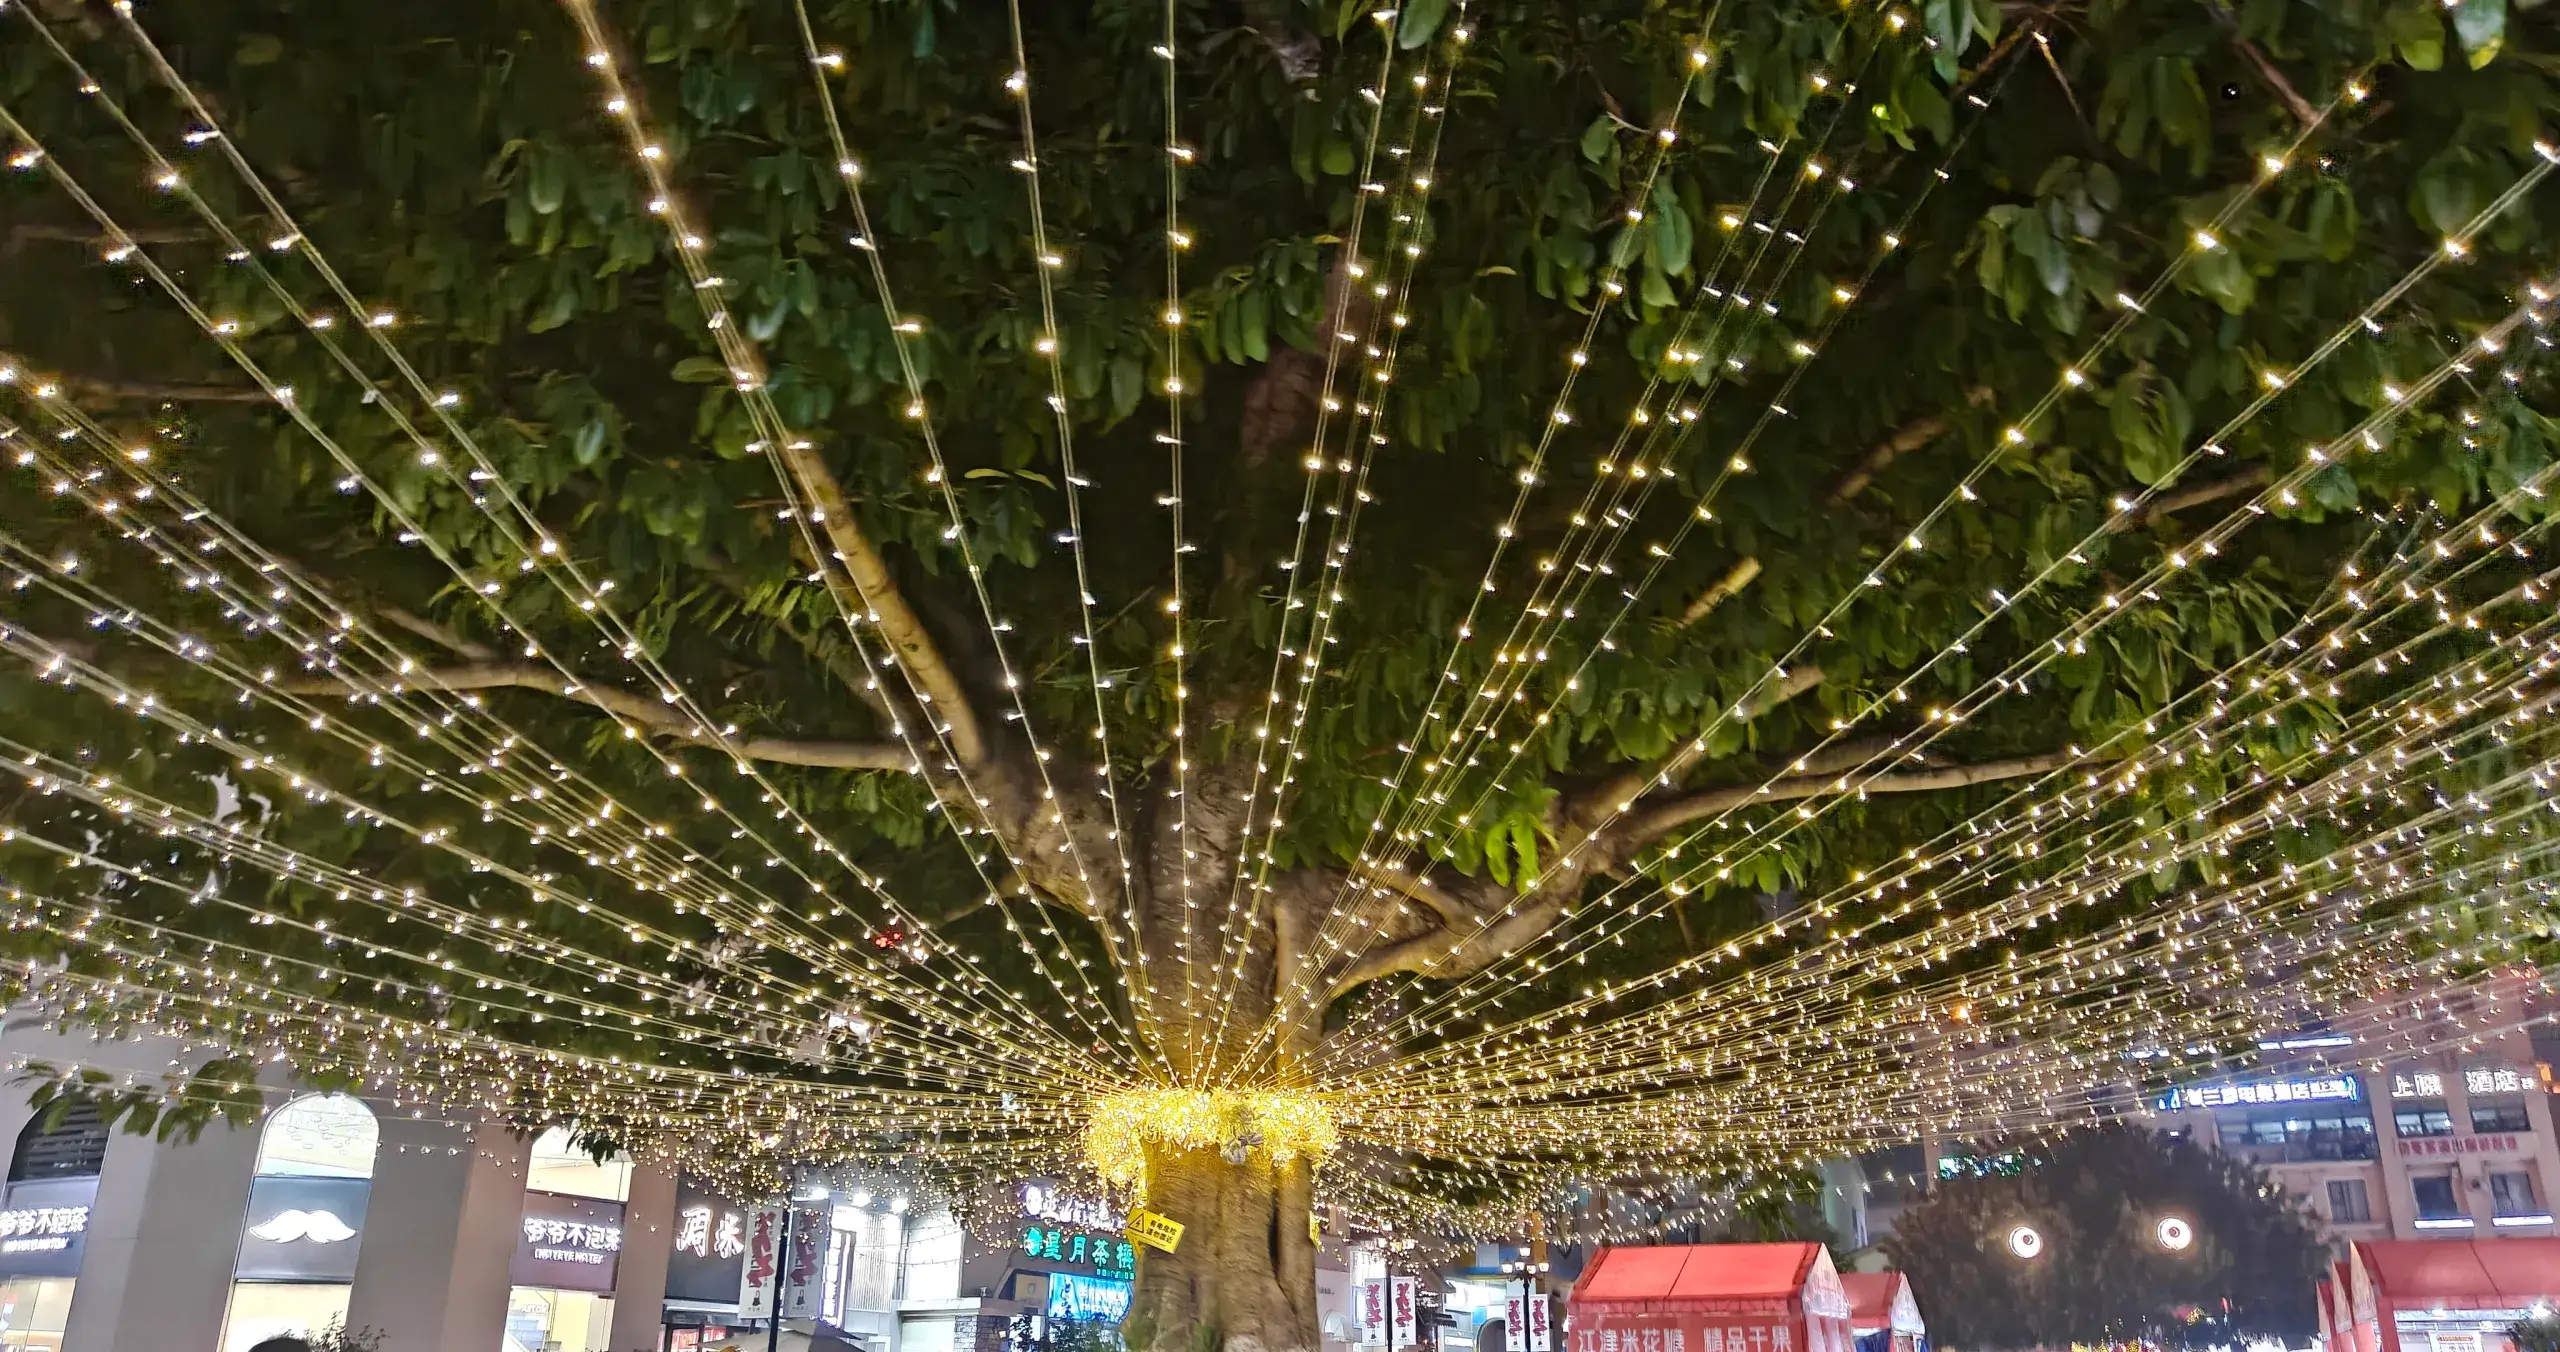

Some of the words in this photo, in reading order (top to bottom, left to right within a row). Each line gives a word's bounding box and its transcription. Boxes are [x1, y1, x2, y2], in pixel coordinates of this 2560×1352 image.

[2465, 1069, 2520, 1094] 酒店
[523, 1217, 621, 1252] 爷爷不泡茶
[1146, 1228, 1174, 1244] 请勿靠近
[1150, 1219, 1178, 1236] 有电危险
[1703, 1325, 1793, 1352] 精品干果
